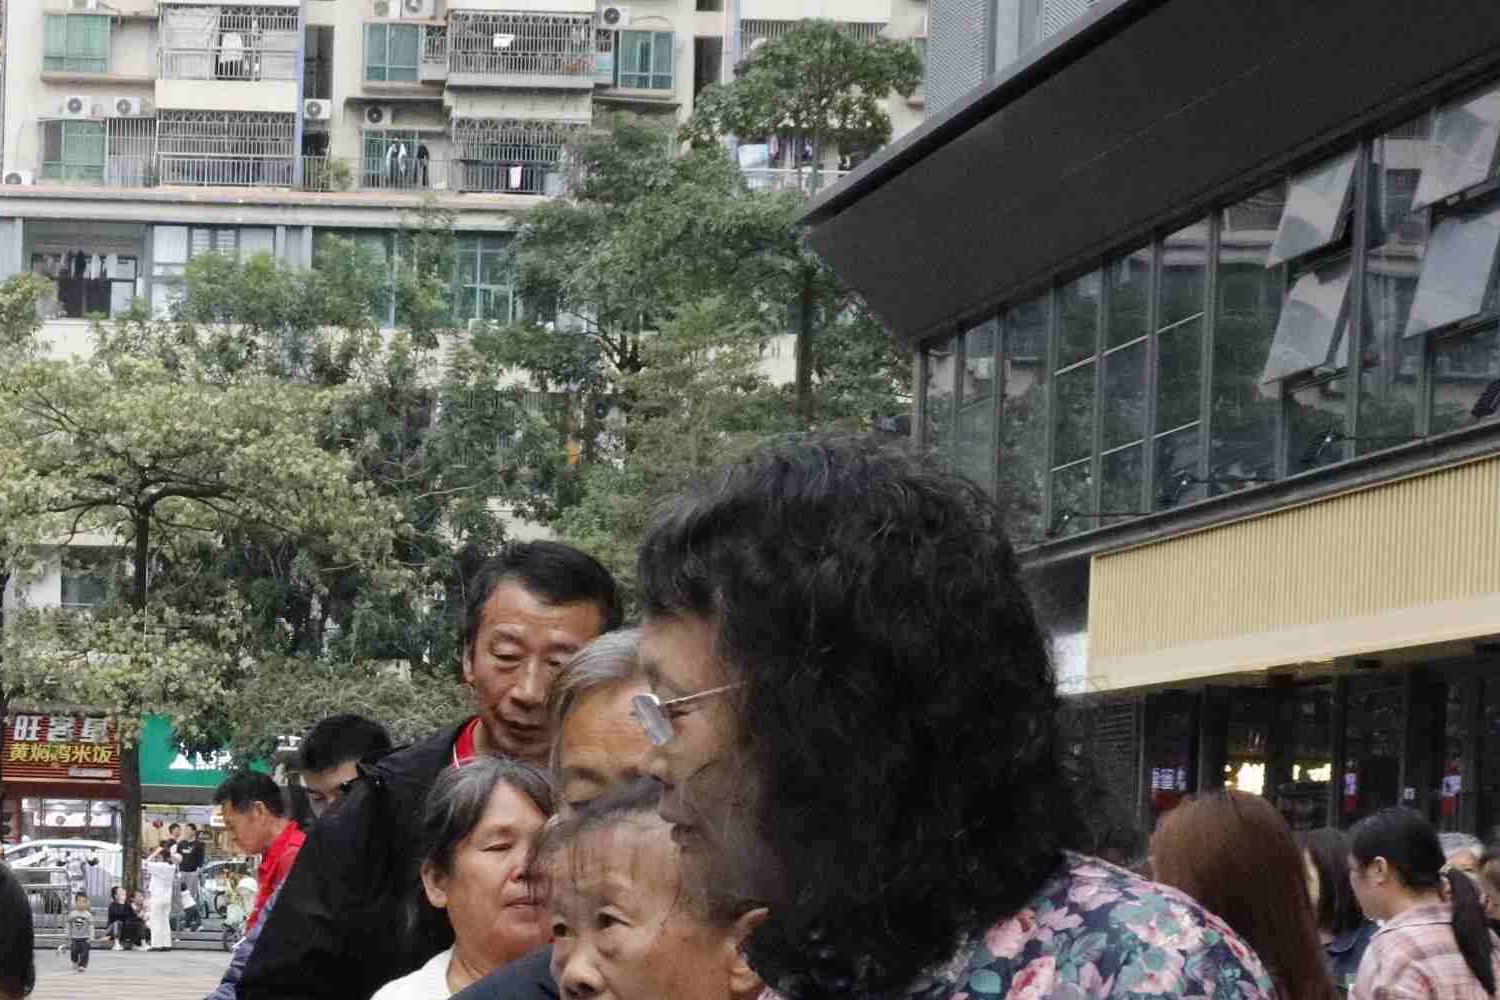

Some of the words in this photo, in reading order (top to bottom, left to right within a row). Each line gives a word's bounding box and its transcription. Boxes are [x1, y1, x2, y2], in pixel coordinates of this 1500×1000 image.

[9, 743, 114, 763] 黄焖鸡米饭
